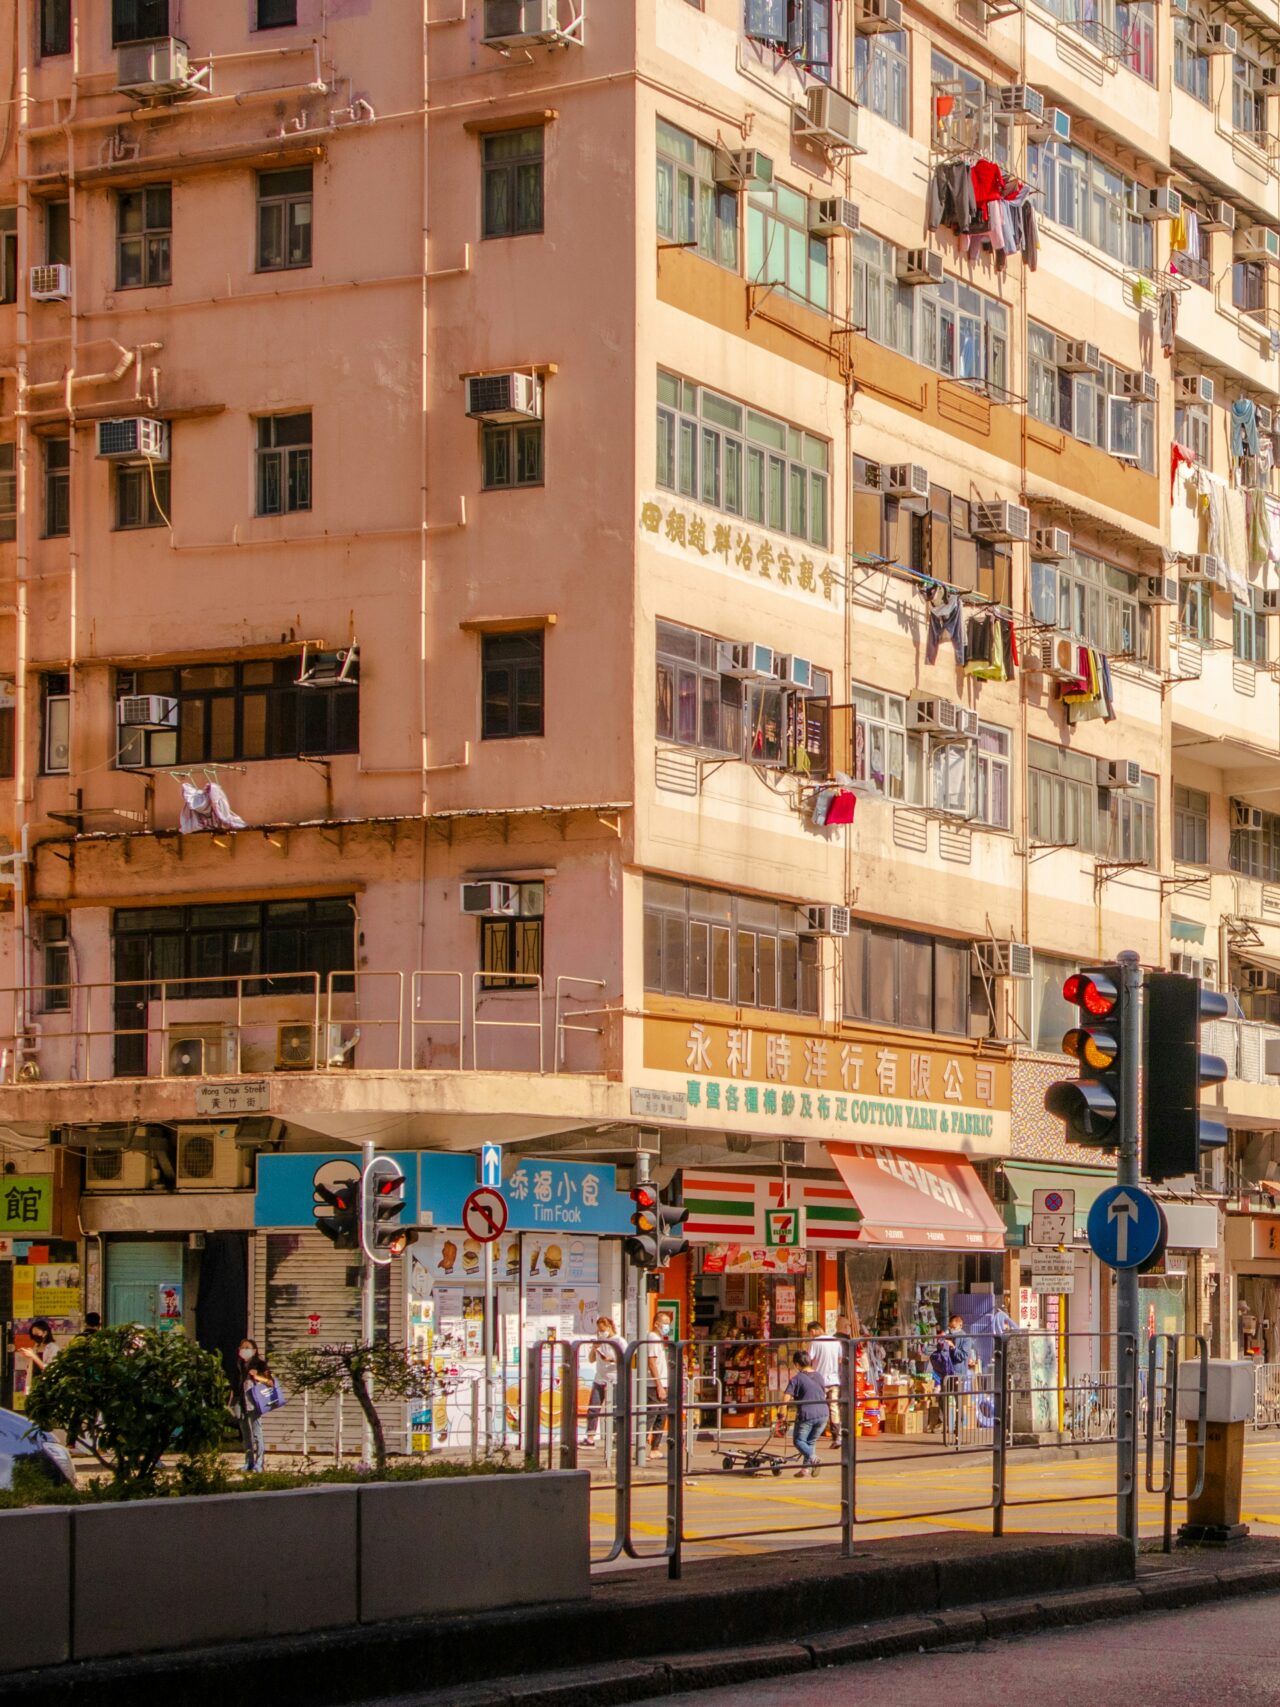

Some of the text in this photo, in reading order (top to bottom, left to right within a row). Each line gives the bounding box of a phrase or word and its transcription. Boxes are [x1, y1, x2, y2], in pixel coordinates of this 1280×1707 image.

[686, 1022, 997, 1108] 永利時洋行有限公司
[201, 1087, 220, 1096] Wong
[244, 1085, 266, 1094] Street
[851, 1101, 994, 1138] COTTON YARN & FABRIC
[509, 1169, 601, 1207] 添福小食
[4, 1185, 42, 1223] 館
[533, 1203, 582, 1223] Tim Fook
[1059, 1216, 1066, 1226] 7
[1058, 1232, 1066, 1243] 7
